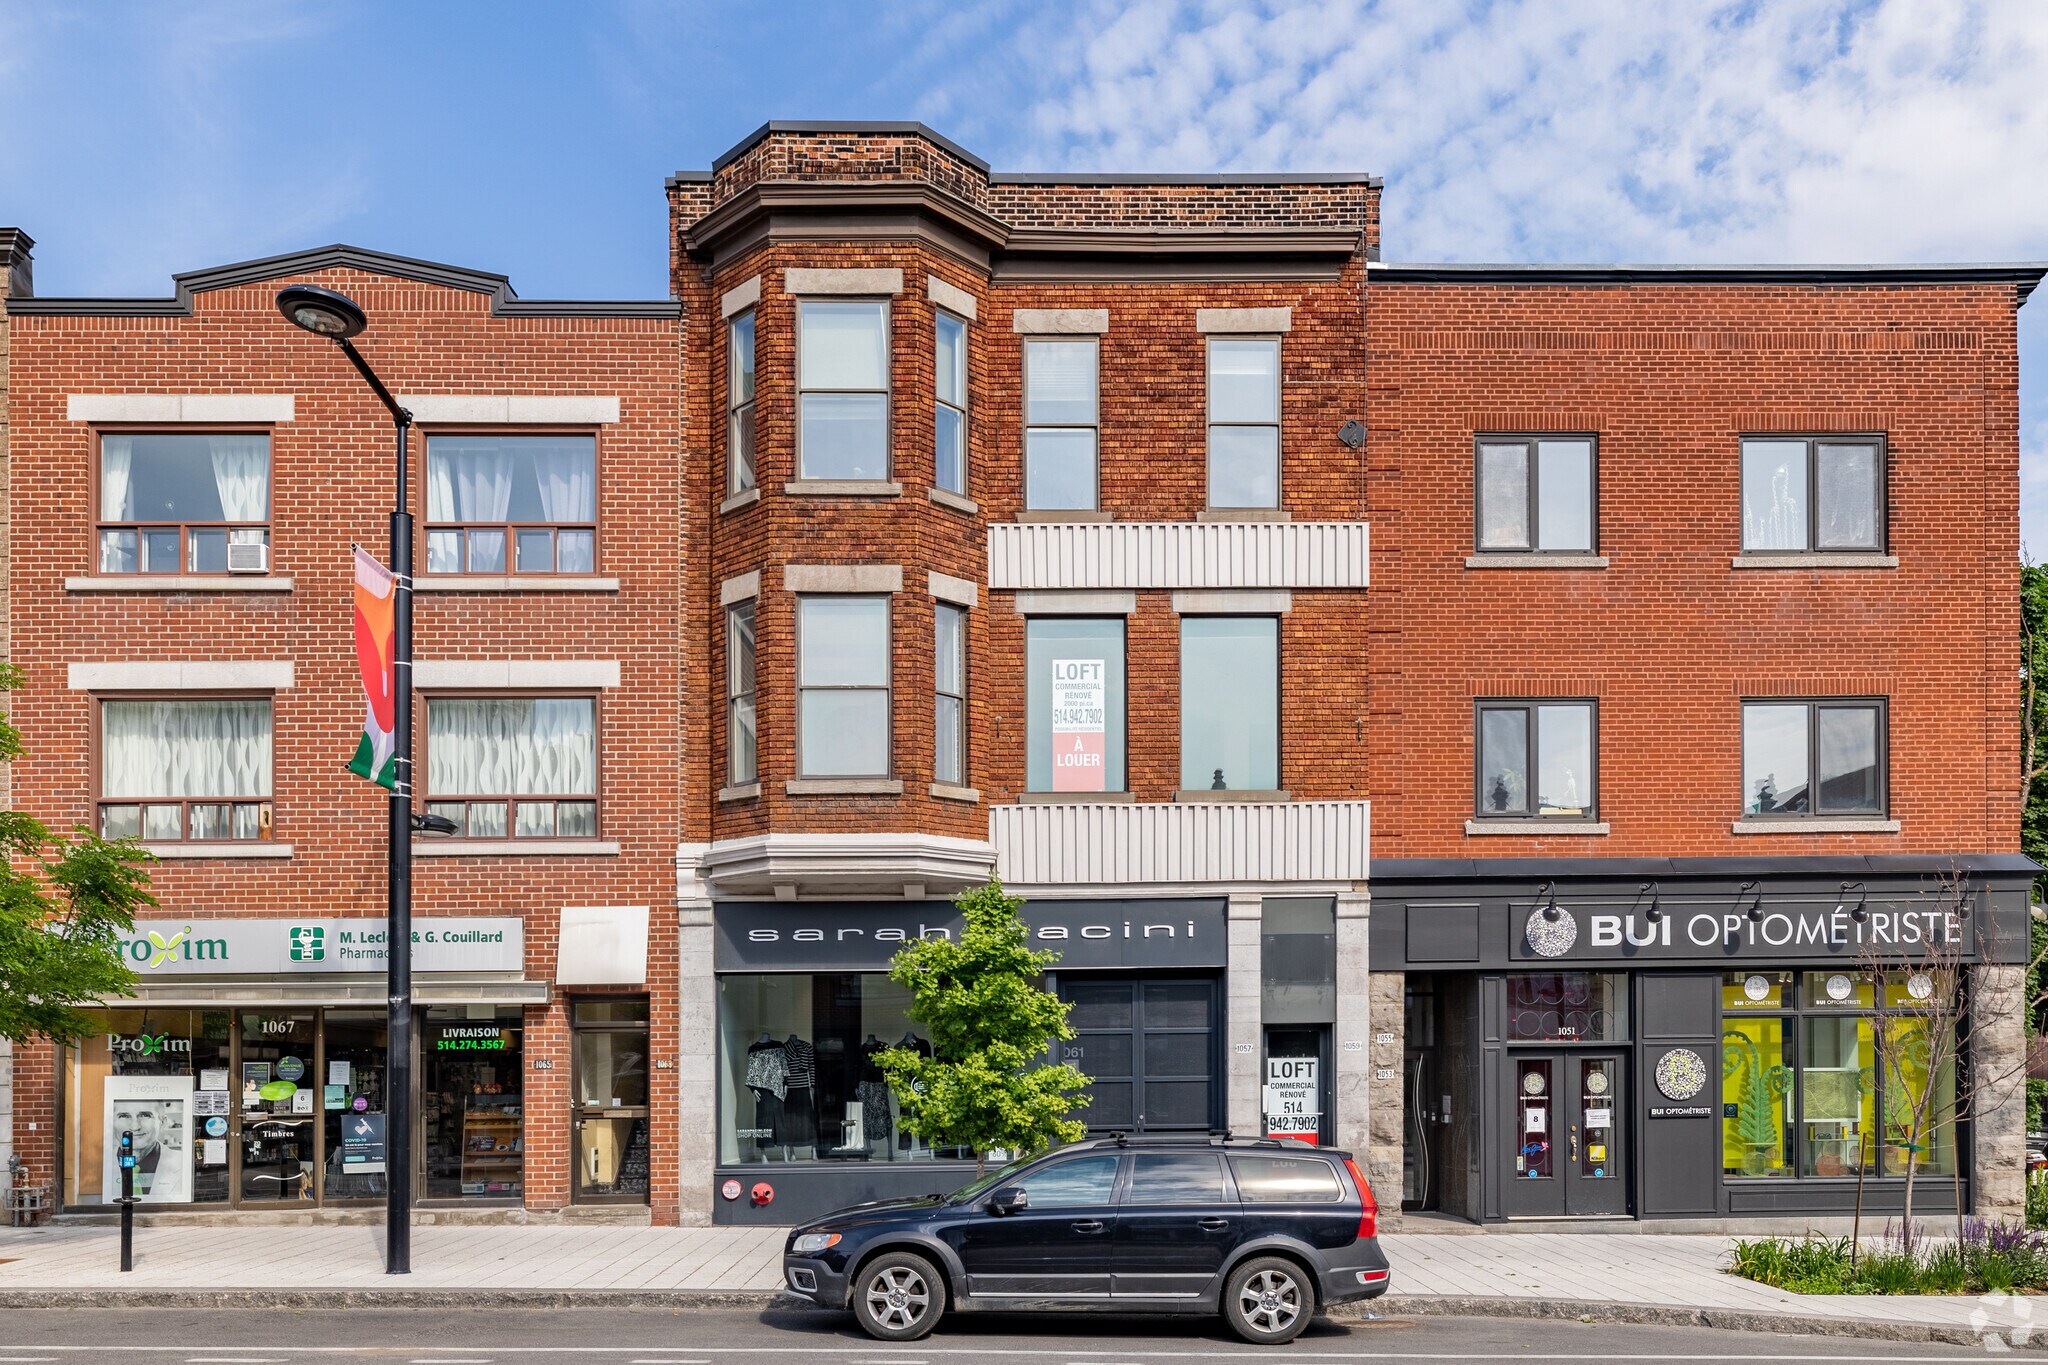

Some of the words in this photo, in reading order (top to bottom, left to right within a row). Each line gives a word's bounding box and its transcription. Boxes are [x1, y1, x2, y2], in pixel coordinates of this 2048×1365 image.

[1055, 663, 1101, 680] LOFT
[1064, 691, 1092, 699] RÉNOVÉ
[1054, 709, 1103, 725] 514.942.7902
[1073, 735, 1084, 751] À
[1057, 753, 1101, 767] LOUER
[748, 923, 951, 942] sarah
[1036, 920, 1194, 940] acini
[1591, 914, 1671, 947] BUI
[1686, 905, 1962, 946] OPTOMÉTRISTE
[339, 931, 356, 944] M.
[360, 931, 390, 944] Lecl
[411, 931, 421, 944] &
[425, 931, 438, 944] G.
[442, 930, 503, 944] Couillard
[116, 925, 229, 969] roxim
[339, 947, 414, 959] Pharmacs
[262, 1020, 295, 1034] 1067
[442, 1027, 500, 1038] LIVRAISON
[1558, 1026, 1576, 1035] 1051
[1378, 1034, 1392, 1042] 1055
[437, 1040, 506, 1050] 514.274.3567
[1345, 1042, 1360, 1050] 1059
[1065, 1046, 1084, 1058] 061
[536, 1060, 552, 1069] 1065
[657, 1060, 674, 1069] 1063
[1270, 1061, 1315, 1079] LOFT
[1378, 1070, 1393, 1078] 1053
[1270, 1082, 1316, 1090] COMMERCIAL
[1279, 1089, 1307, 1098] RÉNOVÉ
[1283, 1101, 1303, 1114] 514
[1665, 1106, 1712, 1115] OPTOMÉTRISTE
[1269, 1116, 1317, 1131] 942.7902
[262, 1130, 295, 1138] Timbres
